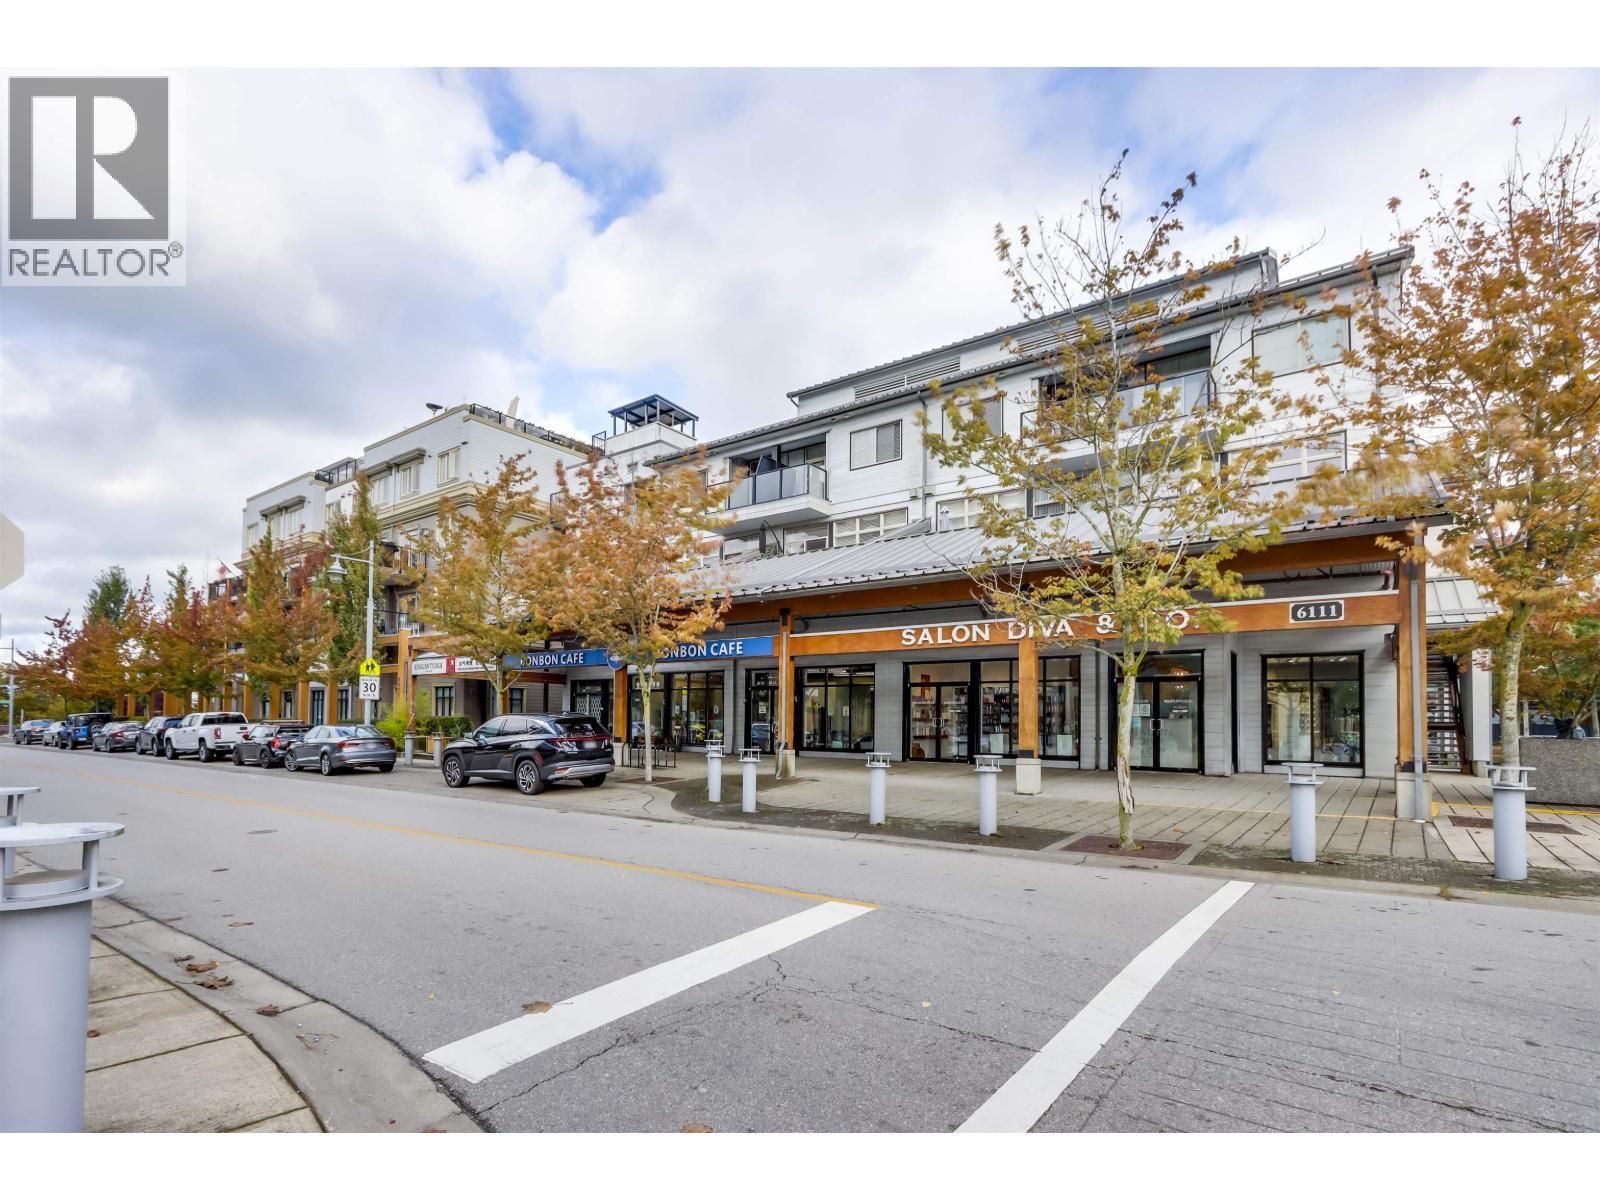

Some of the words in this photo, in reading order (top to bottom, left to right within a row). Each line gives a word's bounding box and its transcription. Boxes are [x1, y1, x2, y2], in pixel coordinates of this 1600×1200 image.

[1296, 604, 1337, 618] 6111
[901, 623, 990, 646] SALON
[1008, 618, 1074, 640] DIVA
[1096, 614, 1118, 634] &
[655, 643, 707, 659] ONBON
[710, 641, 744, 656] CAFE
[560, 652, 584, 665] CAFE
[362, 682, 377, 693] 30
